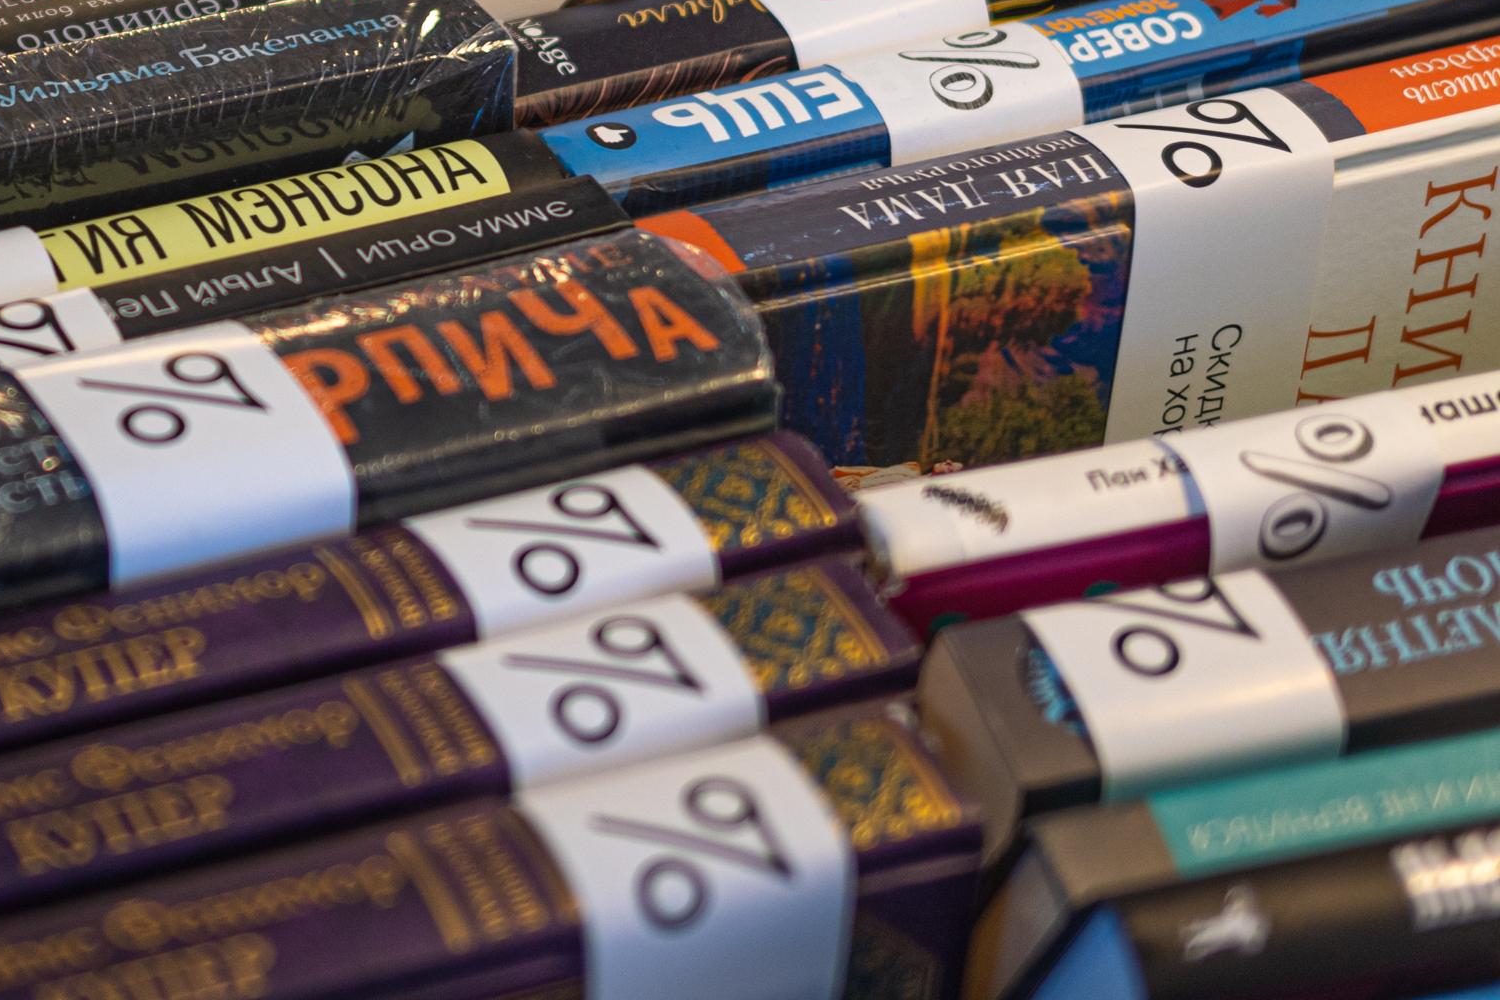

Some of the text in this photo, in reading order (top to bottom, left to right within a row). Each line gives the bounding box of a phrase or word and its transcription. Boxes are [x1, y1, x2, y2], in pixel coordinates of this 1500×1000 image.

[18, 5, 74, 24] боли
[179, 13, 405, 70] Бакеланда
[175, 146, 488, 250] МЭНСОНА
[837, 152, 1113, 231] НАЯ ДАМА
[356, 200, 574, 265] ЭММА ОРЦИ
[184, 260, 303, 307] Алый
[1168, 332, 1200, 378] на
